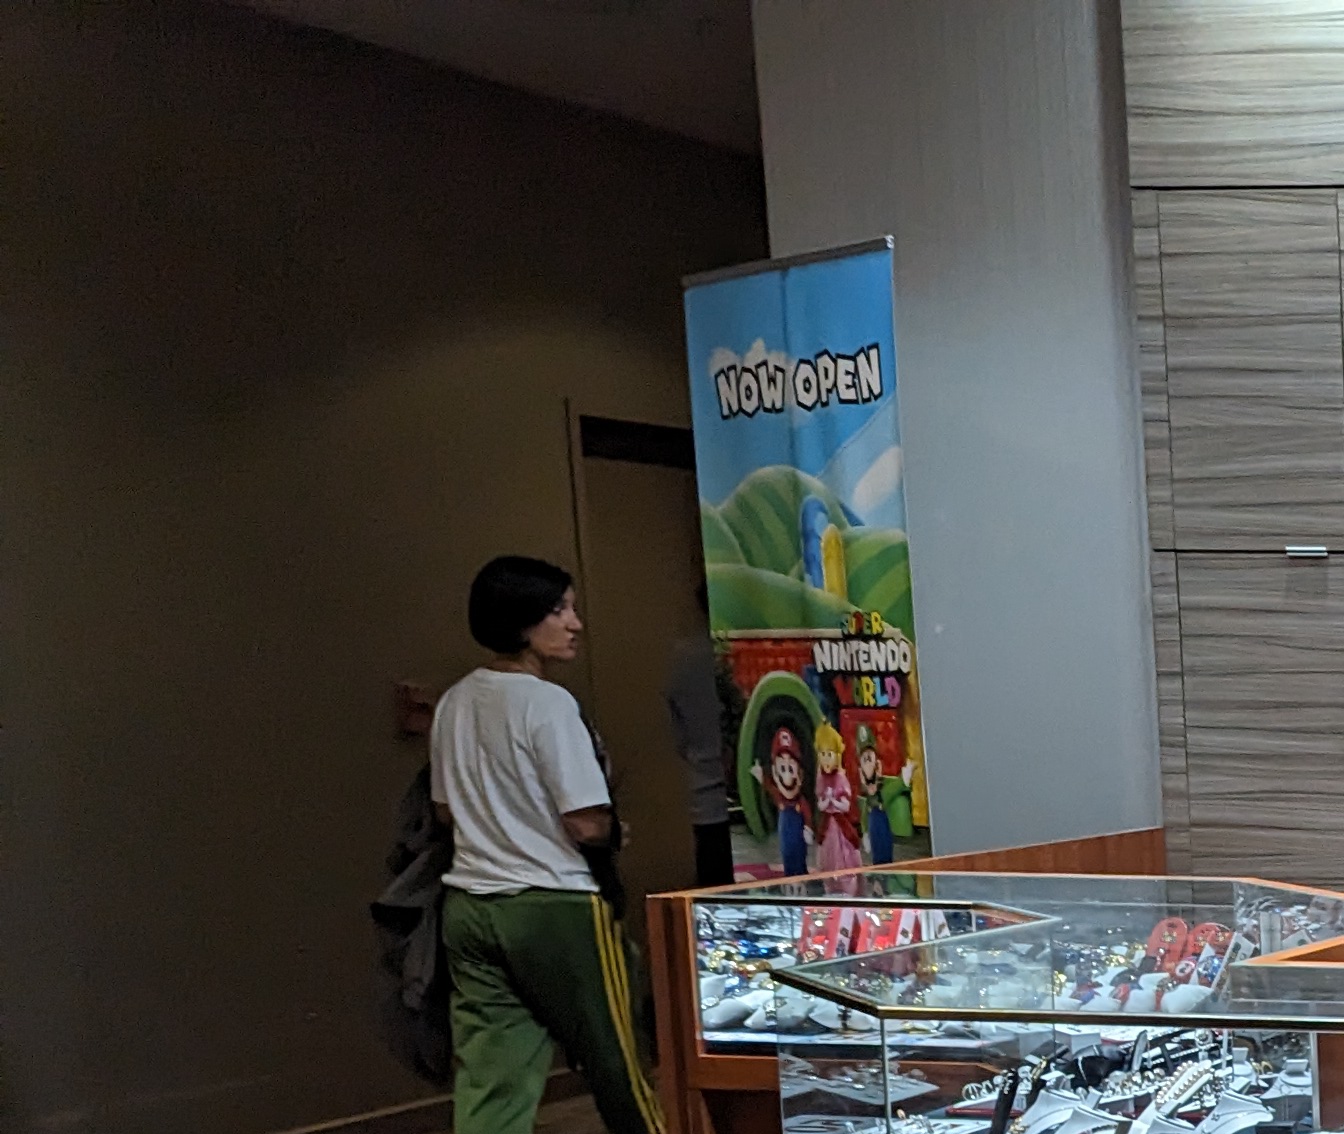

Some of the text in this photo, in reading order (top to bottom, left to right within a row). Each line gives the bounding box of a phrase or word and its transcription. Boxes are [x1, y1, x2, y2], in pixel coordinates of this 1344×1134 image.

[714, 342, 883, 420] NOW OPEN
[812, 638, 912, 674] NINTENDO
[832, 675, 902, 707] WORLD
